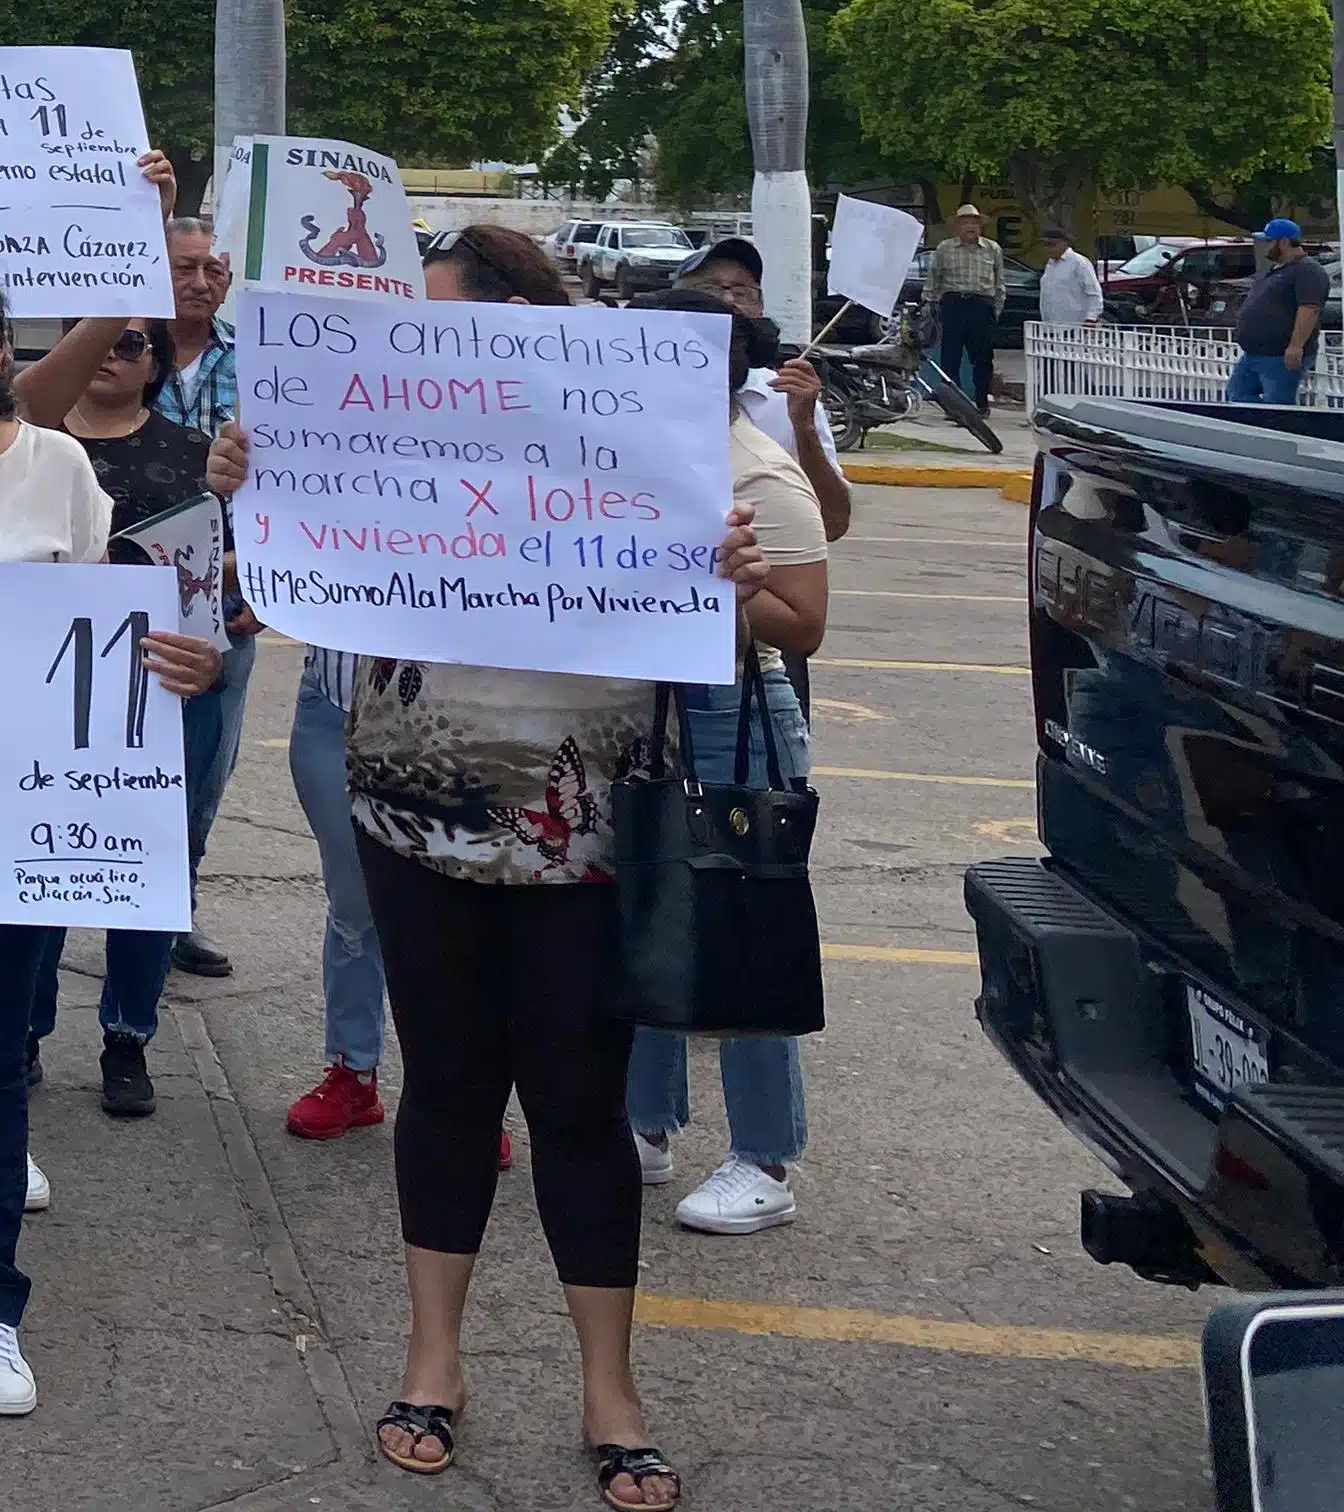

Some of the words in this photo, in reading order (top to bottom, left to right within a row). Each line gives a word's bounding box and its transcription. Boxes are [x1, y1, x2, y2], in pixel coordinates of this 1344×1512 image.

[30, 104, 68, 138] 11
[80, 120, 104, 139] de
[41, 140, 138, 157] septiembre
[285, 148, 393, 184] SINALOA
[49, 160, 126, 187] estatal
[284, 266, 415, 300] PRESENTE
[389, 316, 710, 369] antorchistas
[254, 366, 315, 405] de
[339, 373, 531, 415] AHOME
[562, 387, 644, 417] nos
[253, 424, 504, 464] sumaremos
[524, 443, 550, 470] a
[579, 435, 619, 471] la
[254, 469, 439, 503] marcha
[527, 474, 662, 522] lotes
[300, 519, 505, 559] vivienda
[519, 531, 552, 567] el
[573, 535, 604, 567] 11
[617, 534, 661, 571] de
[45, 610, 150, 750] 11
[19, 760, 55, 790] de
[30, 821, 97, 855] 9:30
